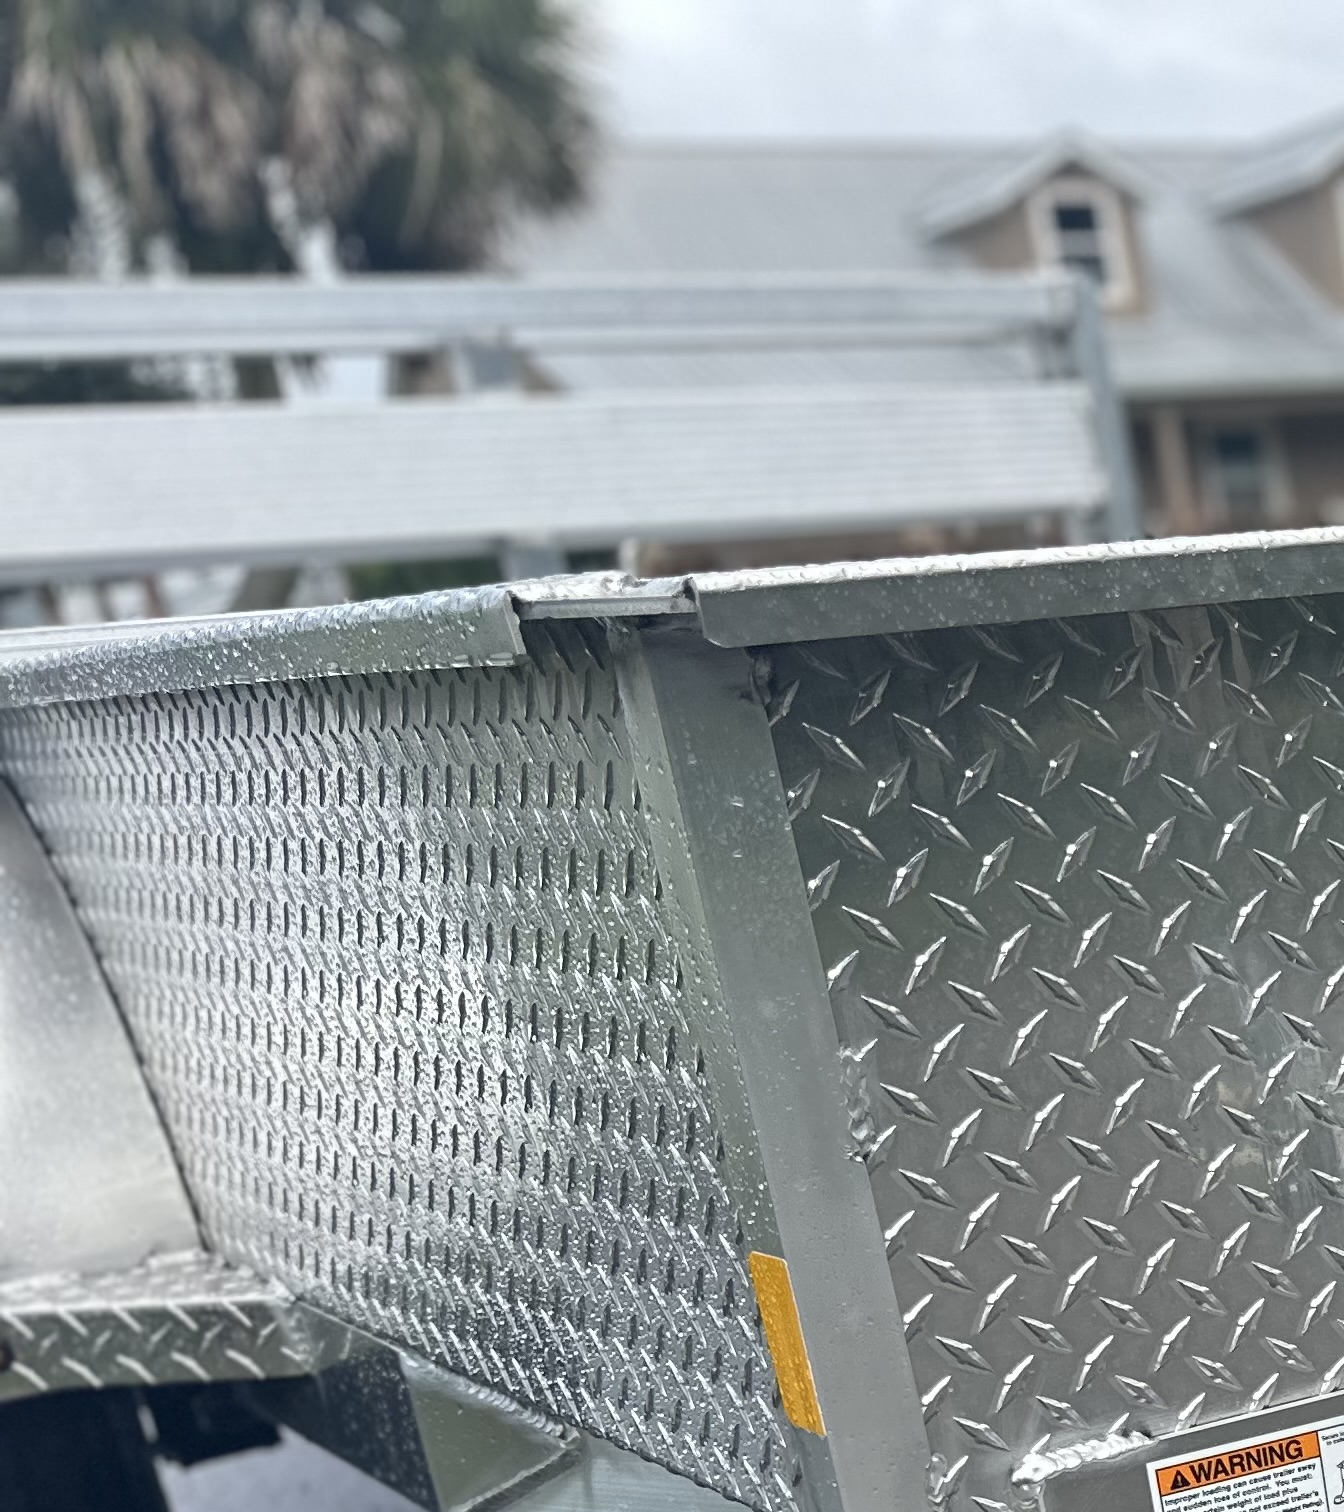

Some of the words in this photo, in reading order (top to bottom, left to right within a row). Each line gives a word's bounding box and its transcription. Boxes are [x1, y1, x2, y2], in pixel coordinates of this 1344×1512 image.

[1189, 1439, 1303, 1484] WARNING
[1165, 1492, 1200, 1507] Improper
[1202, 1484, 1231, 1498] loading
[1233, 1481, 1247, 1489] can
[1249, 1475, 1271, 1484] cause
[1273, 1467, 1295, 1478] trailer
[1297, 1463, 1316, 1473] away
[1183, 1499, 1211, 1511] sudden
[1214, 1494, 1230, 1503] loss
[1232, 1491, 1240, 1499] of
[1242, 1483, 1272, 1496] control.
[1275, 1479, 1290, 1487] You
[1227, 1498, 1253, 1511] weight
[1254, 1495, 1262, 1503] of
[1264, 1491, 1280, 1500] load
[1282, 1486, 1298, 1496] plus
[1263, 1498, 1289, 1510] exceed
